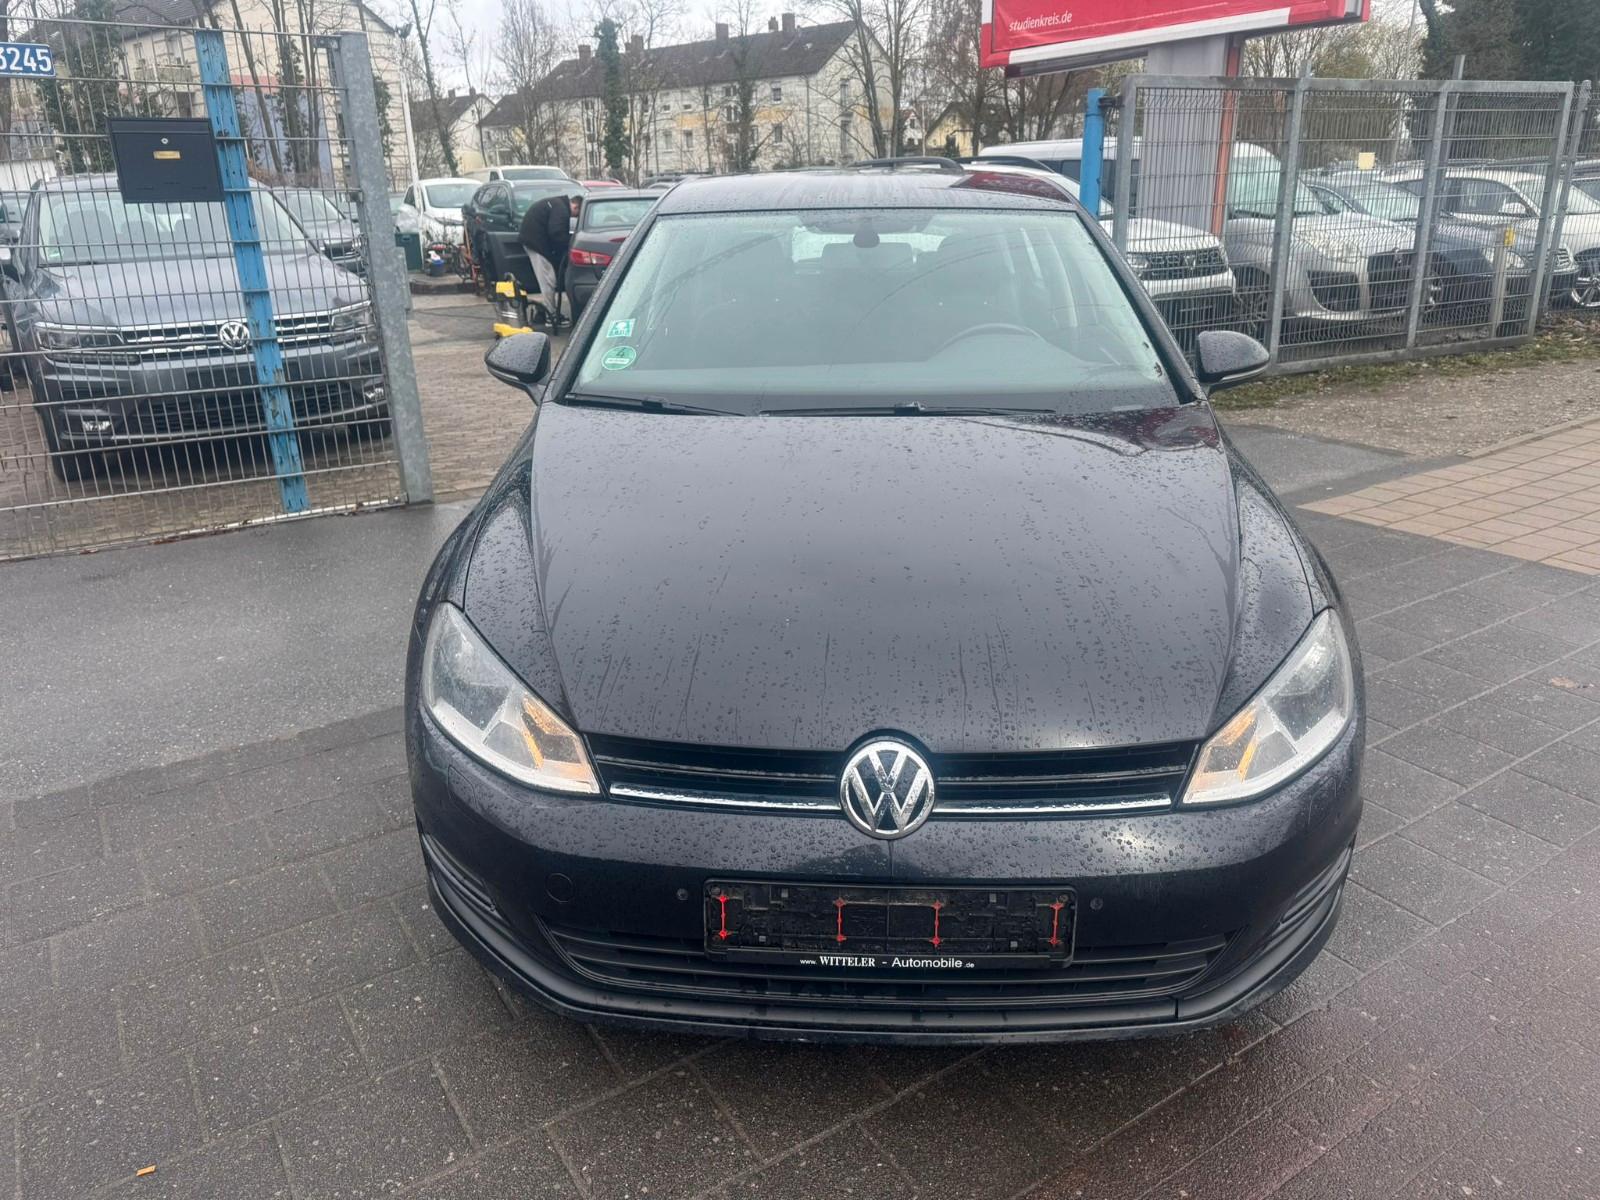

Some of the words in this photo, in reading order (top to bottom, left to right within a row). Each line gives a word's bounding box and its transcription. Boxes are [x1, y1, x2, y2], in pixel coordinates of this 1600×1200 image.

[1009, 10, 1073, 32] studienkreis.de
[841, 740, 935, 840] VW
[819, 955, 876, 968] WITTELER
[891, 957, 963, 969] Automobile
